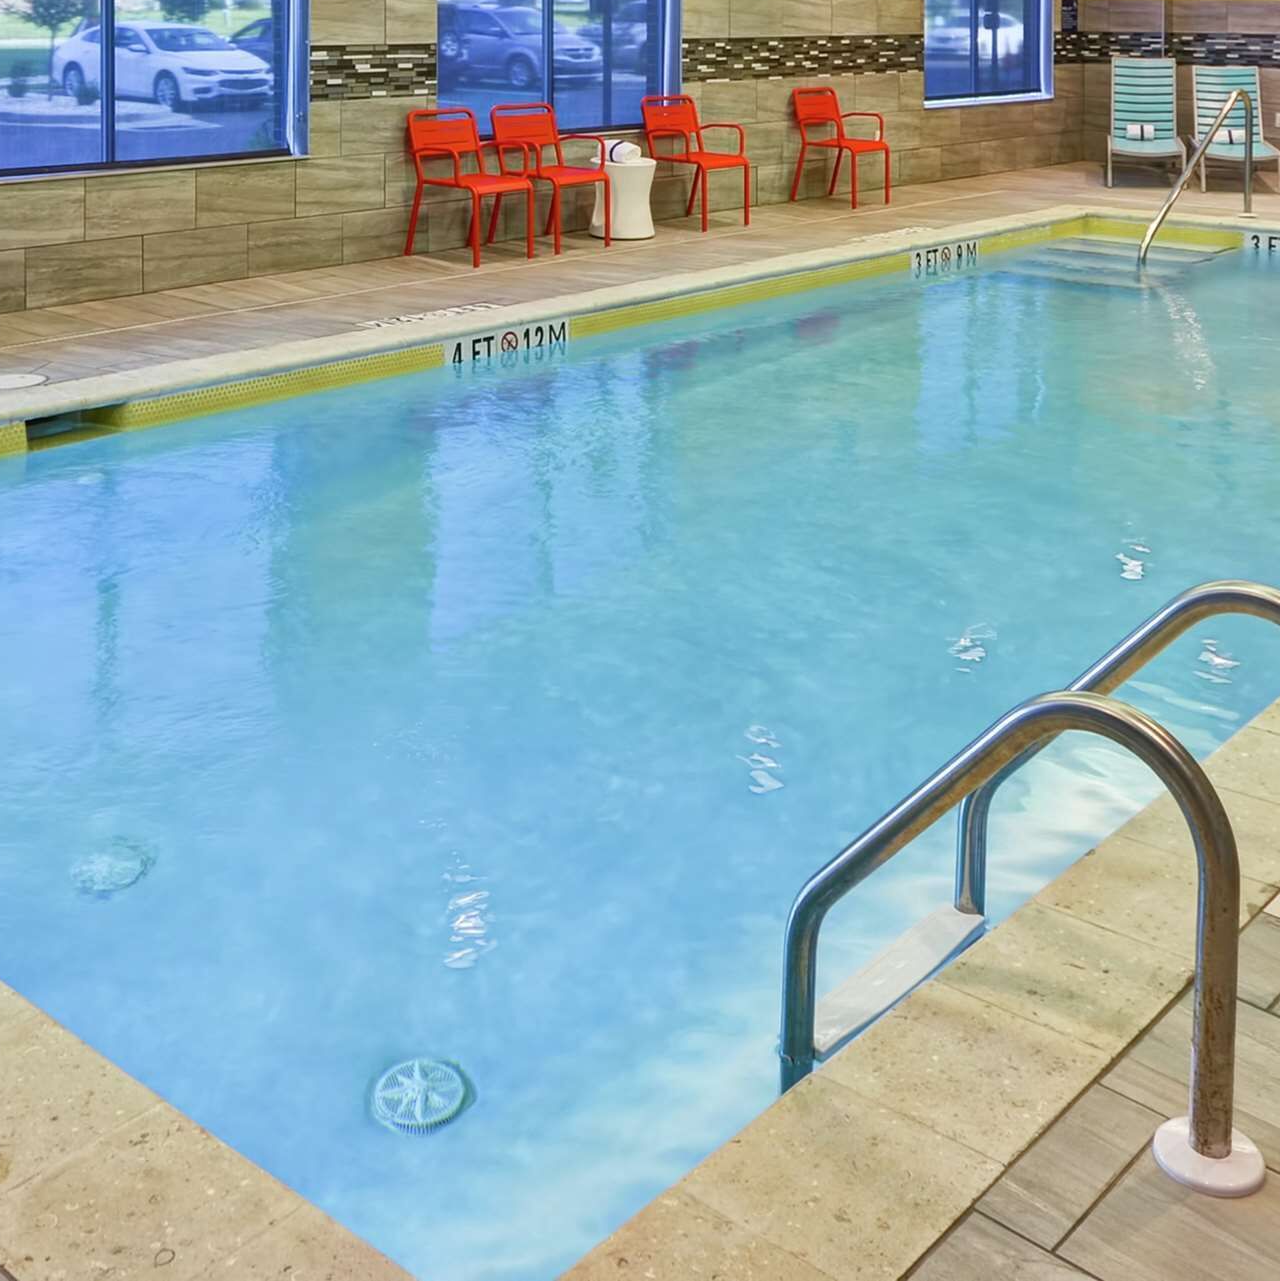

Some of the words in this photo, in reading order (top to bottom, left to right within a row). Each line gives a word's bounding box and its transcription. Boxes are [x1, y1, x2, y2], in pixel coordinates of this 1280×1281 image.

[967, 242, 976, 257] M
[452, 342, 463, 364] 4
[472, 336, 494, 361] FT
[549, 321, 566, 345] M
